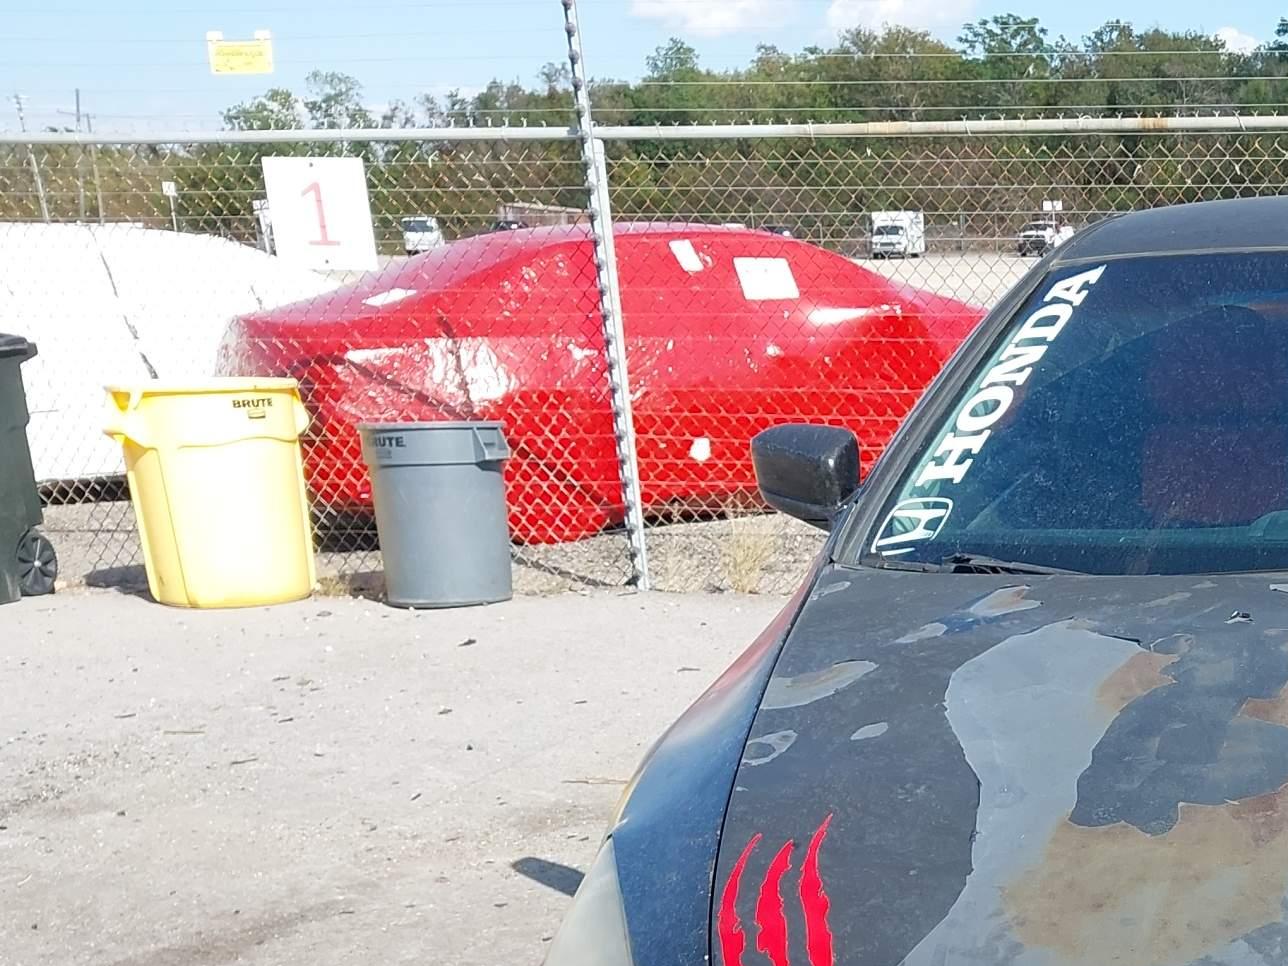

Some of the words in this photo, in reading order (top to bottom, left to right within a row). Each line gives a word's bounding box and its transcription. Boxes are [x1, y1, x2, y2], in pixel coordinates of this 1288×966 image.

[301, 181, 341, 246] 1
[231, 397, 273, 409] BRUTE
[915, 264, 1108, 487] HONDA
